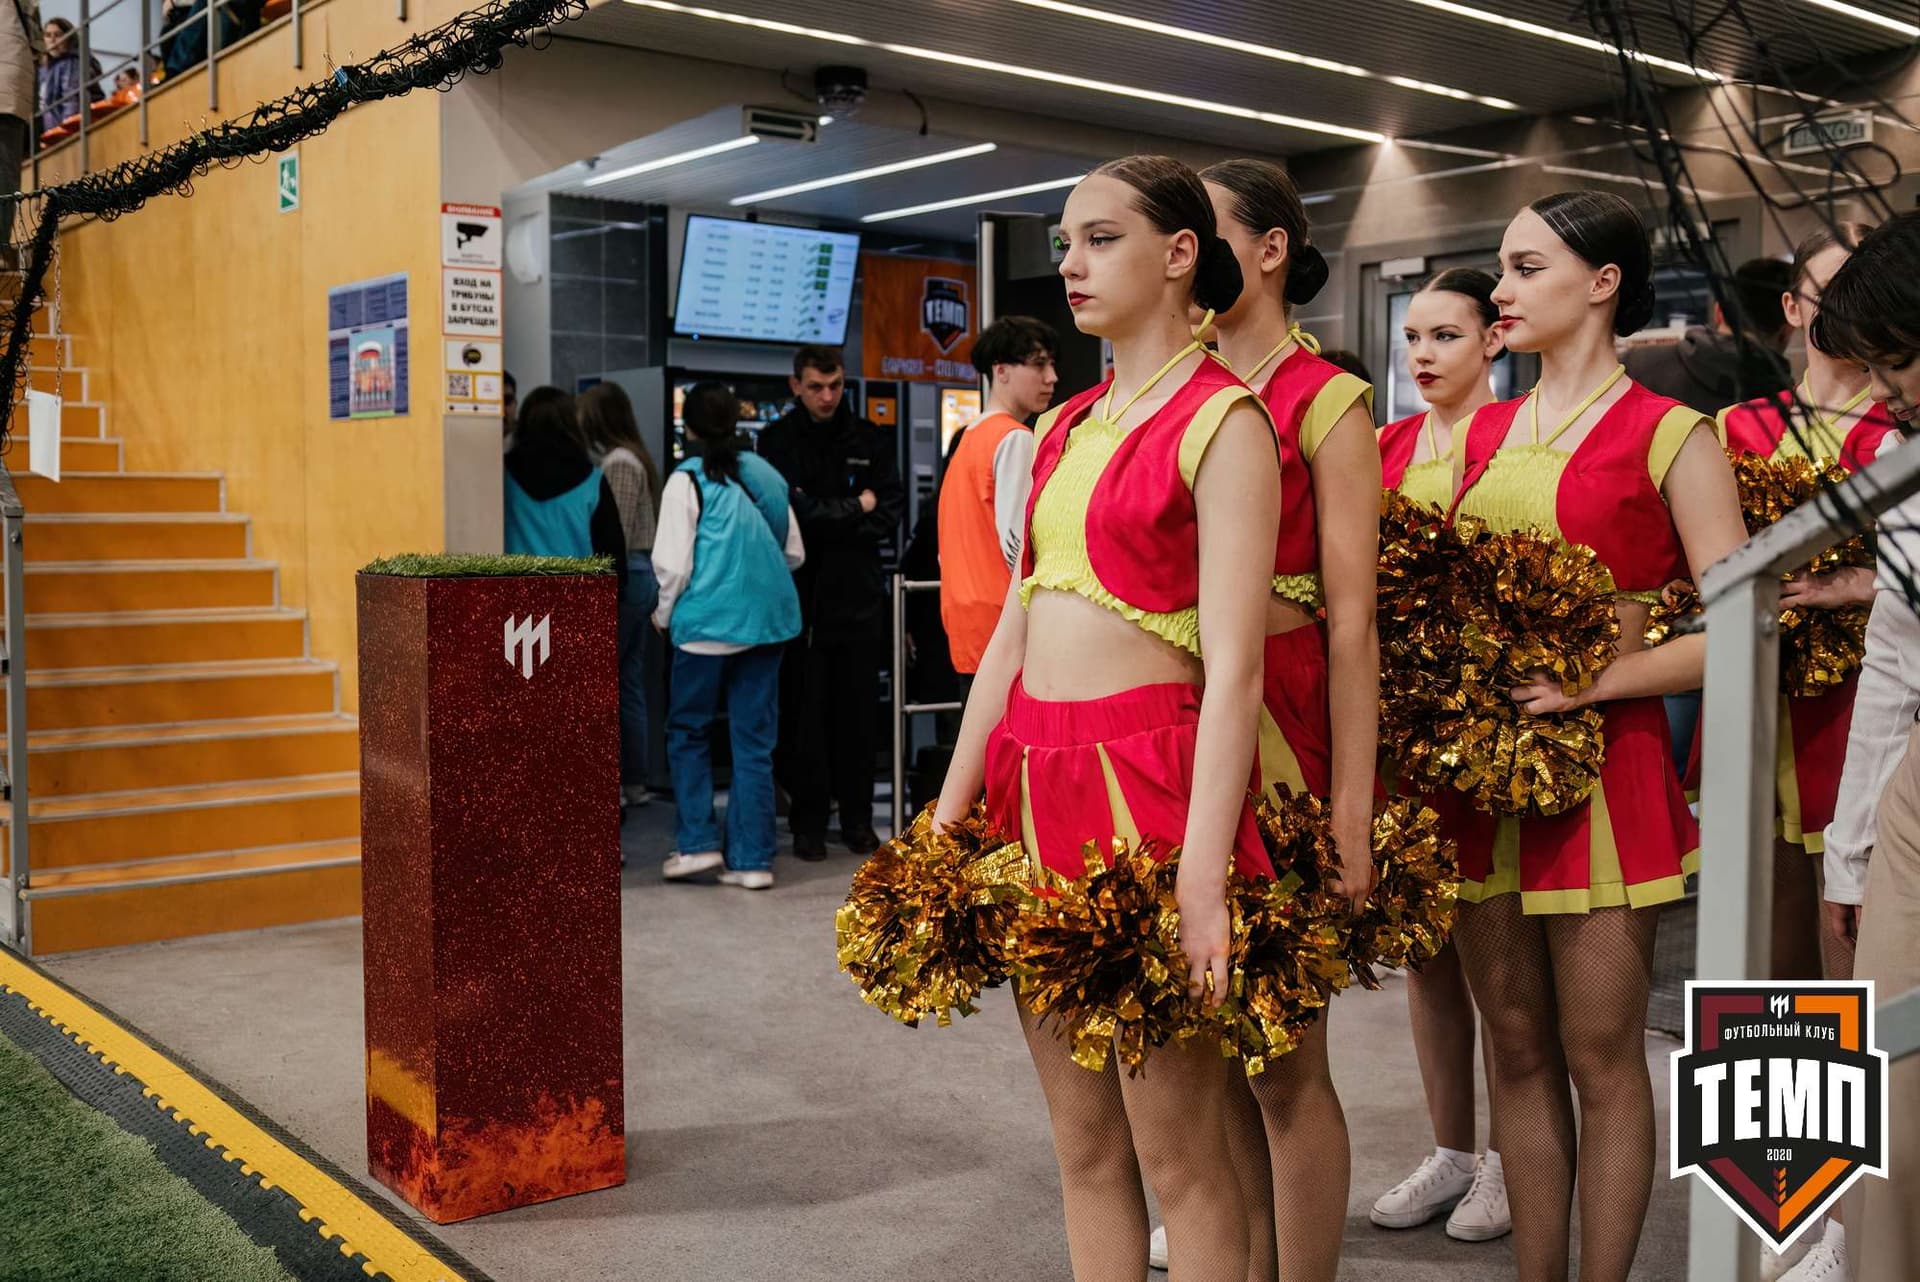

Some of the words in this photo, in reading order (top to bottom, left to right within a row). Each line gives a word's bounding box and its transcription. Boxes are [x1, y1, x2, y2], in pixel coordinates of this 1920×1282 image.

[453, 278, 477, 288] ВХОД
[480, 279, 491, 287] НА
[451, 290, 494, 301] ТРИБУНЫ
[451, 303, 457, 311] В
[460, 304, 494, 313] БУТСАХ
